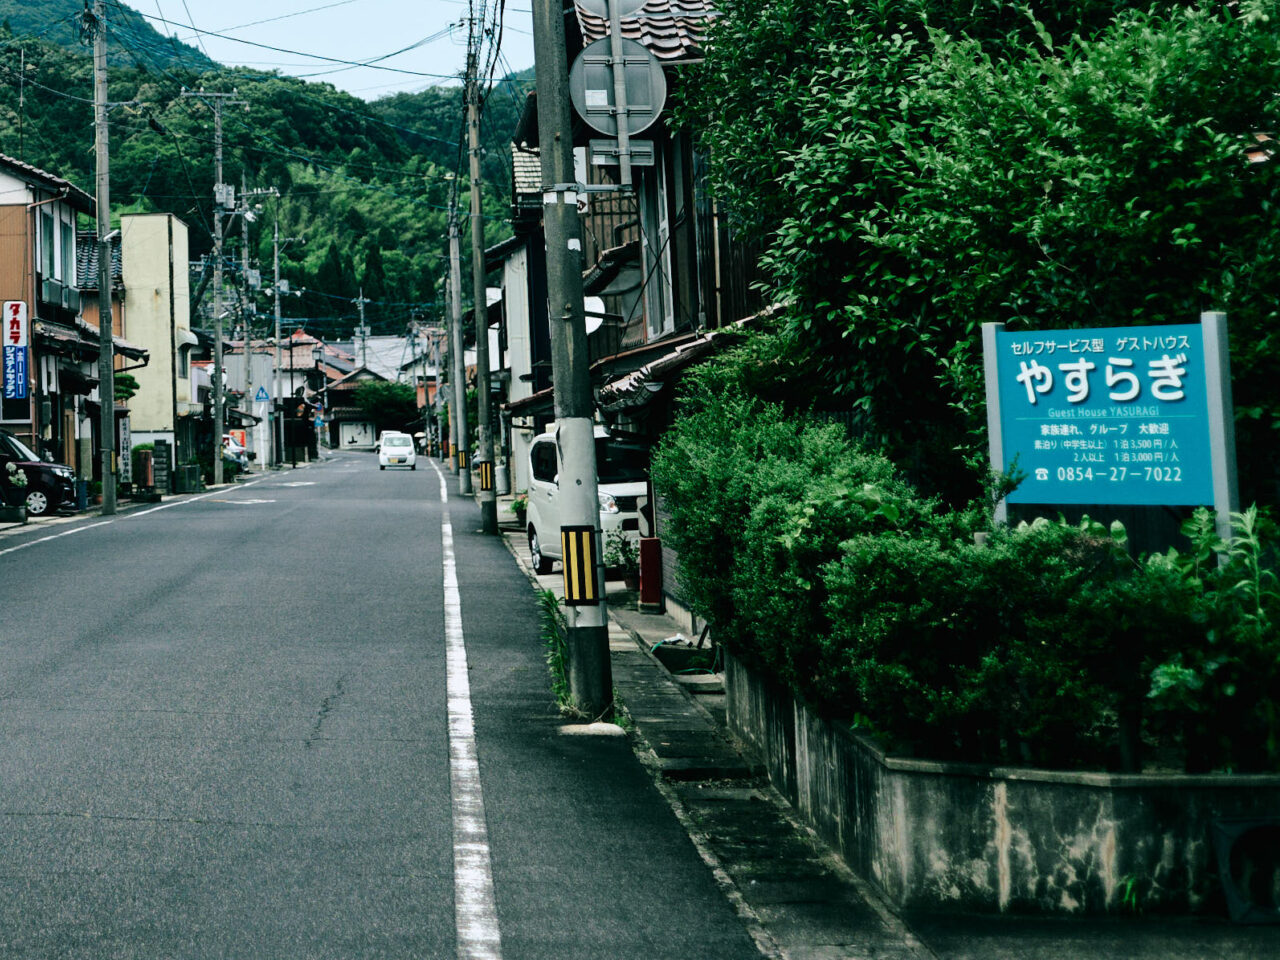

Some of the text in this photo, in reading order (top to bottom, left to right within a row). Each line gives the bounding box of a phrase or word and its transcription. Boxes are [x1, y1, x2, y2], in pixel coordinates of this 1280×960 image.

[9, 303, 21, 344] タカラ
[1011, 335, 1190, 355] セルフサービス型 ゲストハウス
[1016, 352, 1187, 404] やすらぎ
[1048, 406, 1159, 418] Guest House YASURAGI
